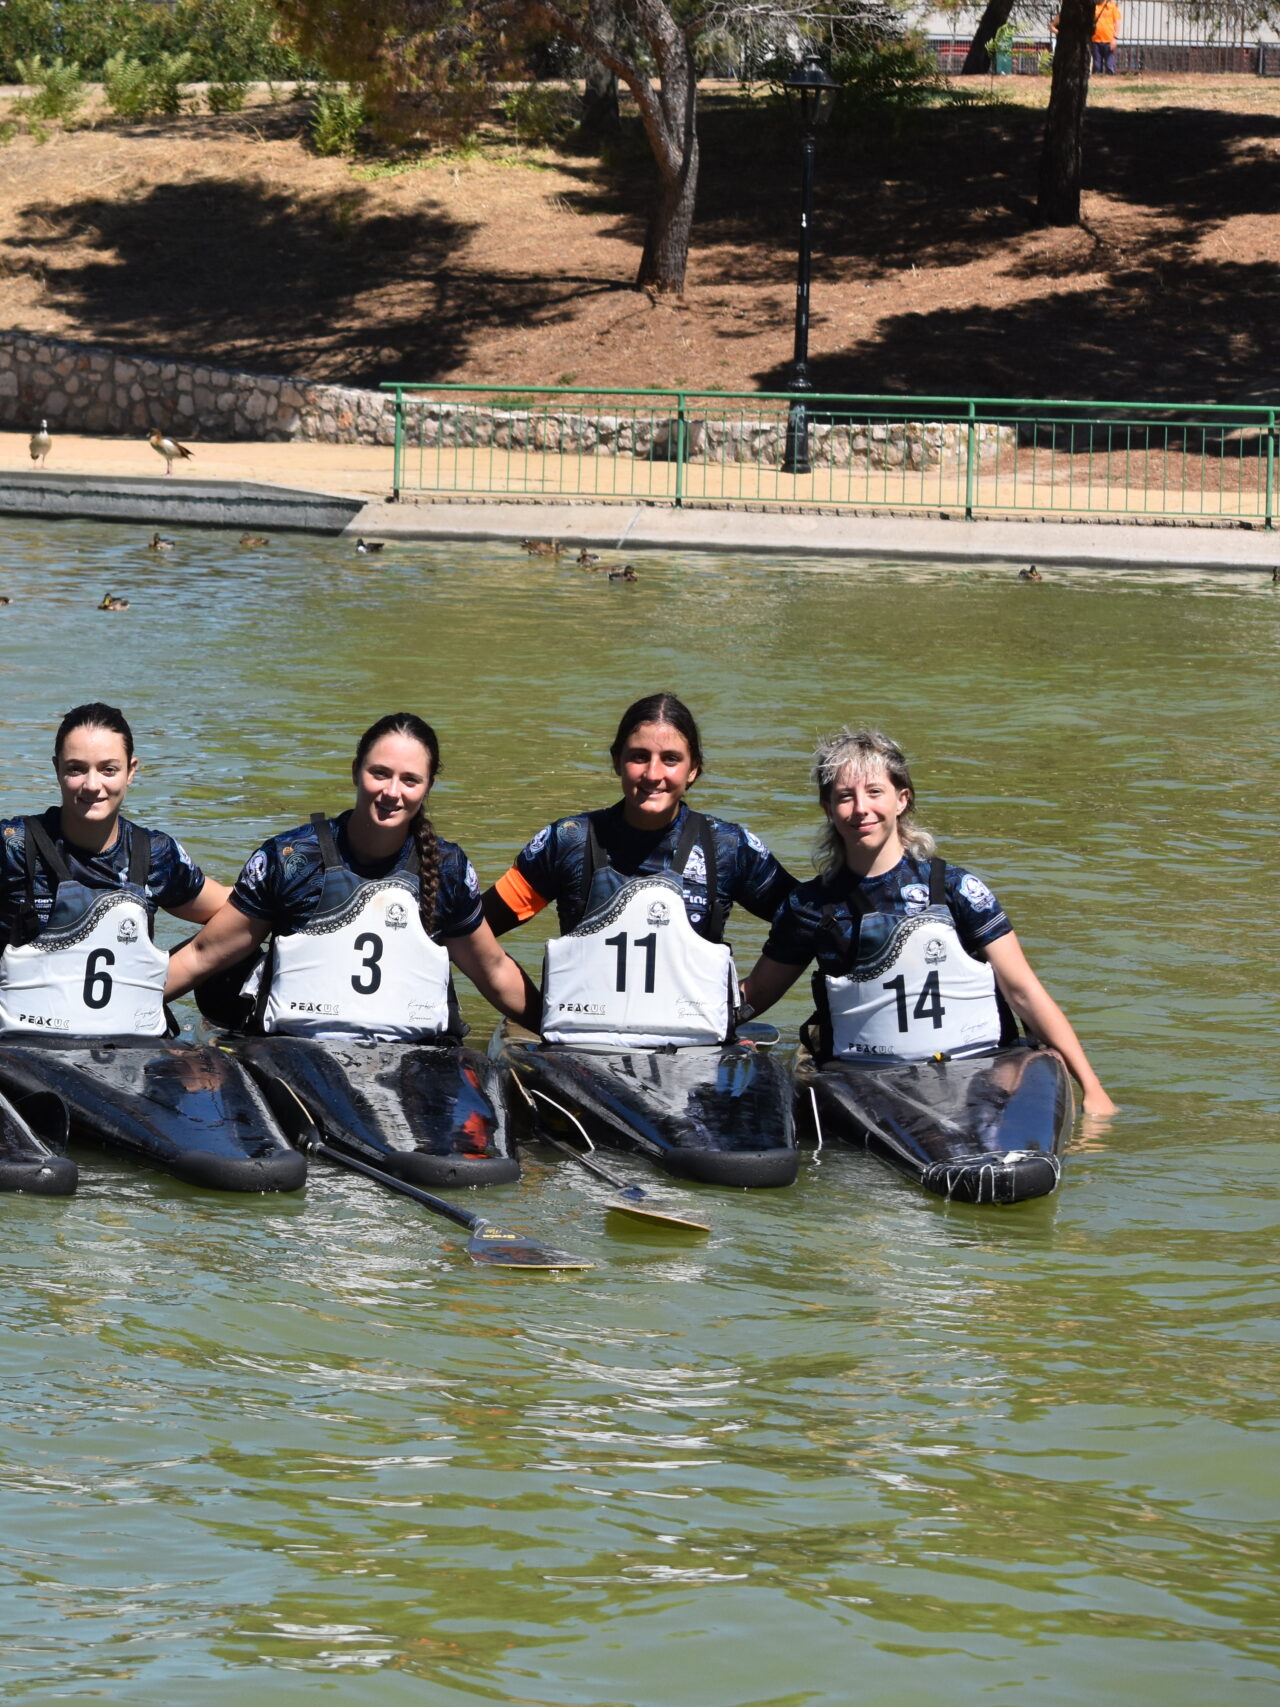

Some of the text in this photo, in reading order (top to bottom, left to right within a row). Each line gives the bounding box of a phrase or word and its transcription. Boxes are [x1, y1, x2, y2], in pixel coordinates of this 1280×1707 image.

[82, 948, 115, 1010] 6
[351, 932, 383, 995] 3
[605, 931, 656, 993] 11
[883, 970, 945, 1033] 14
